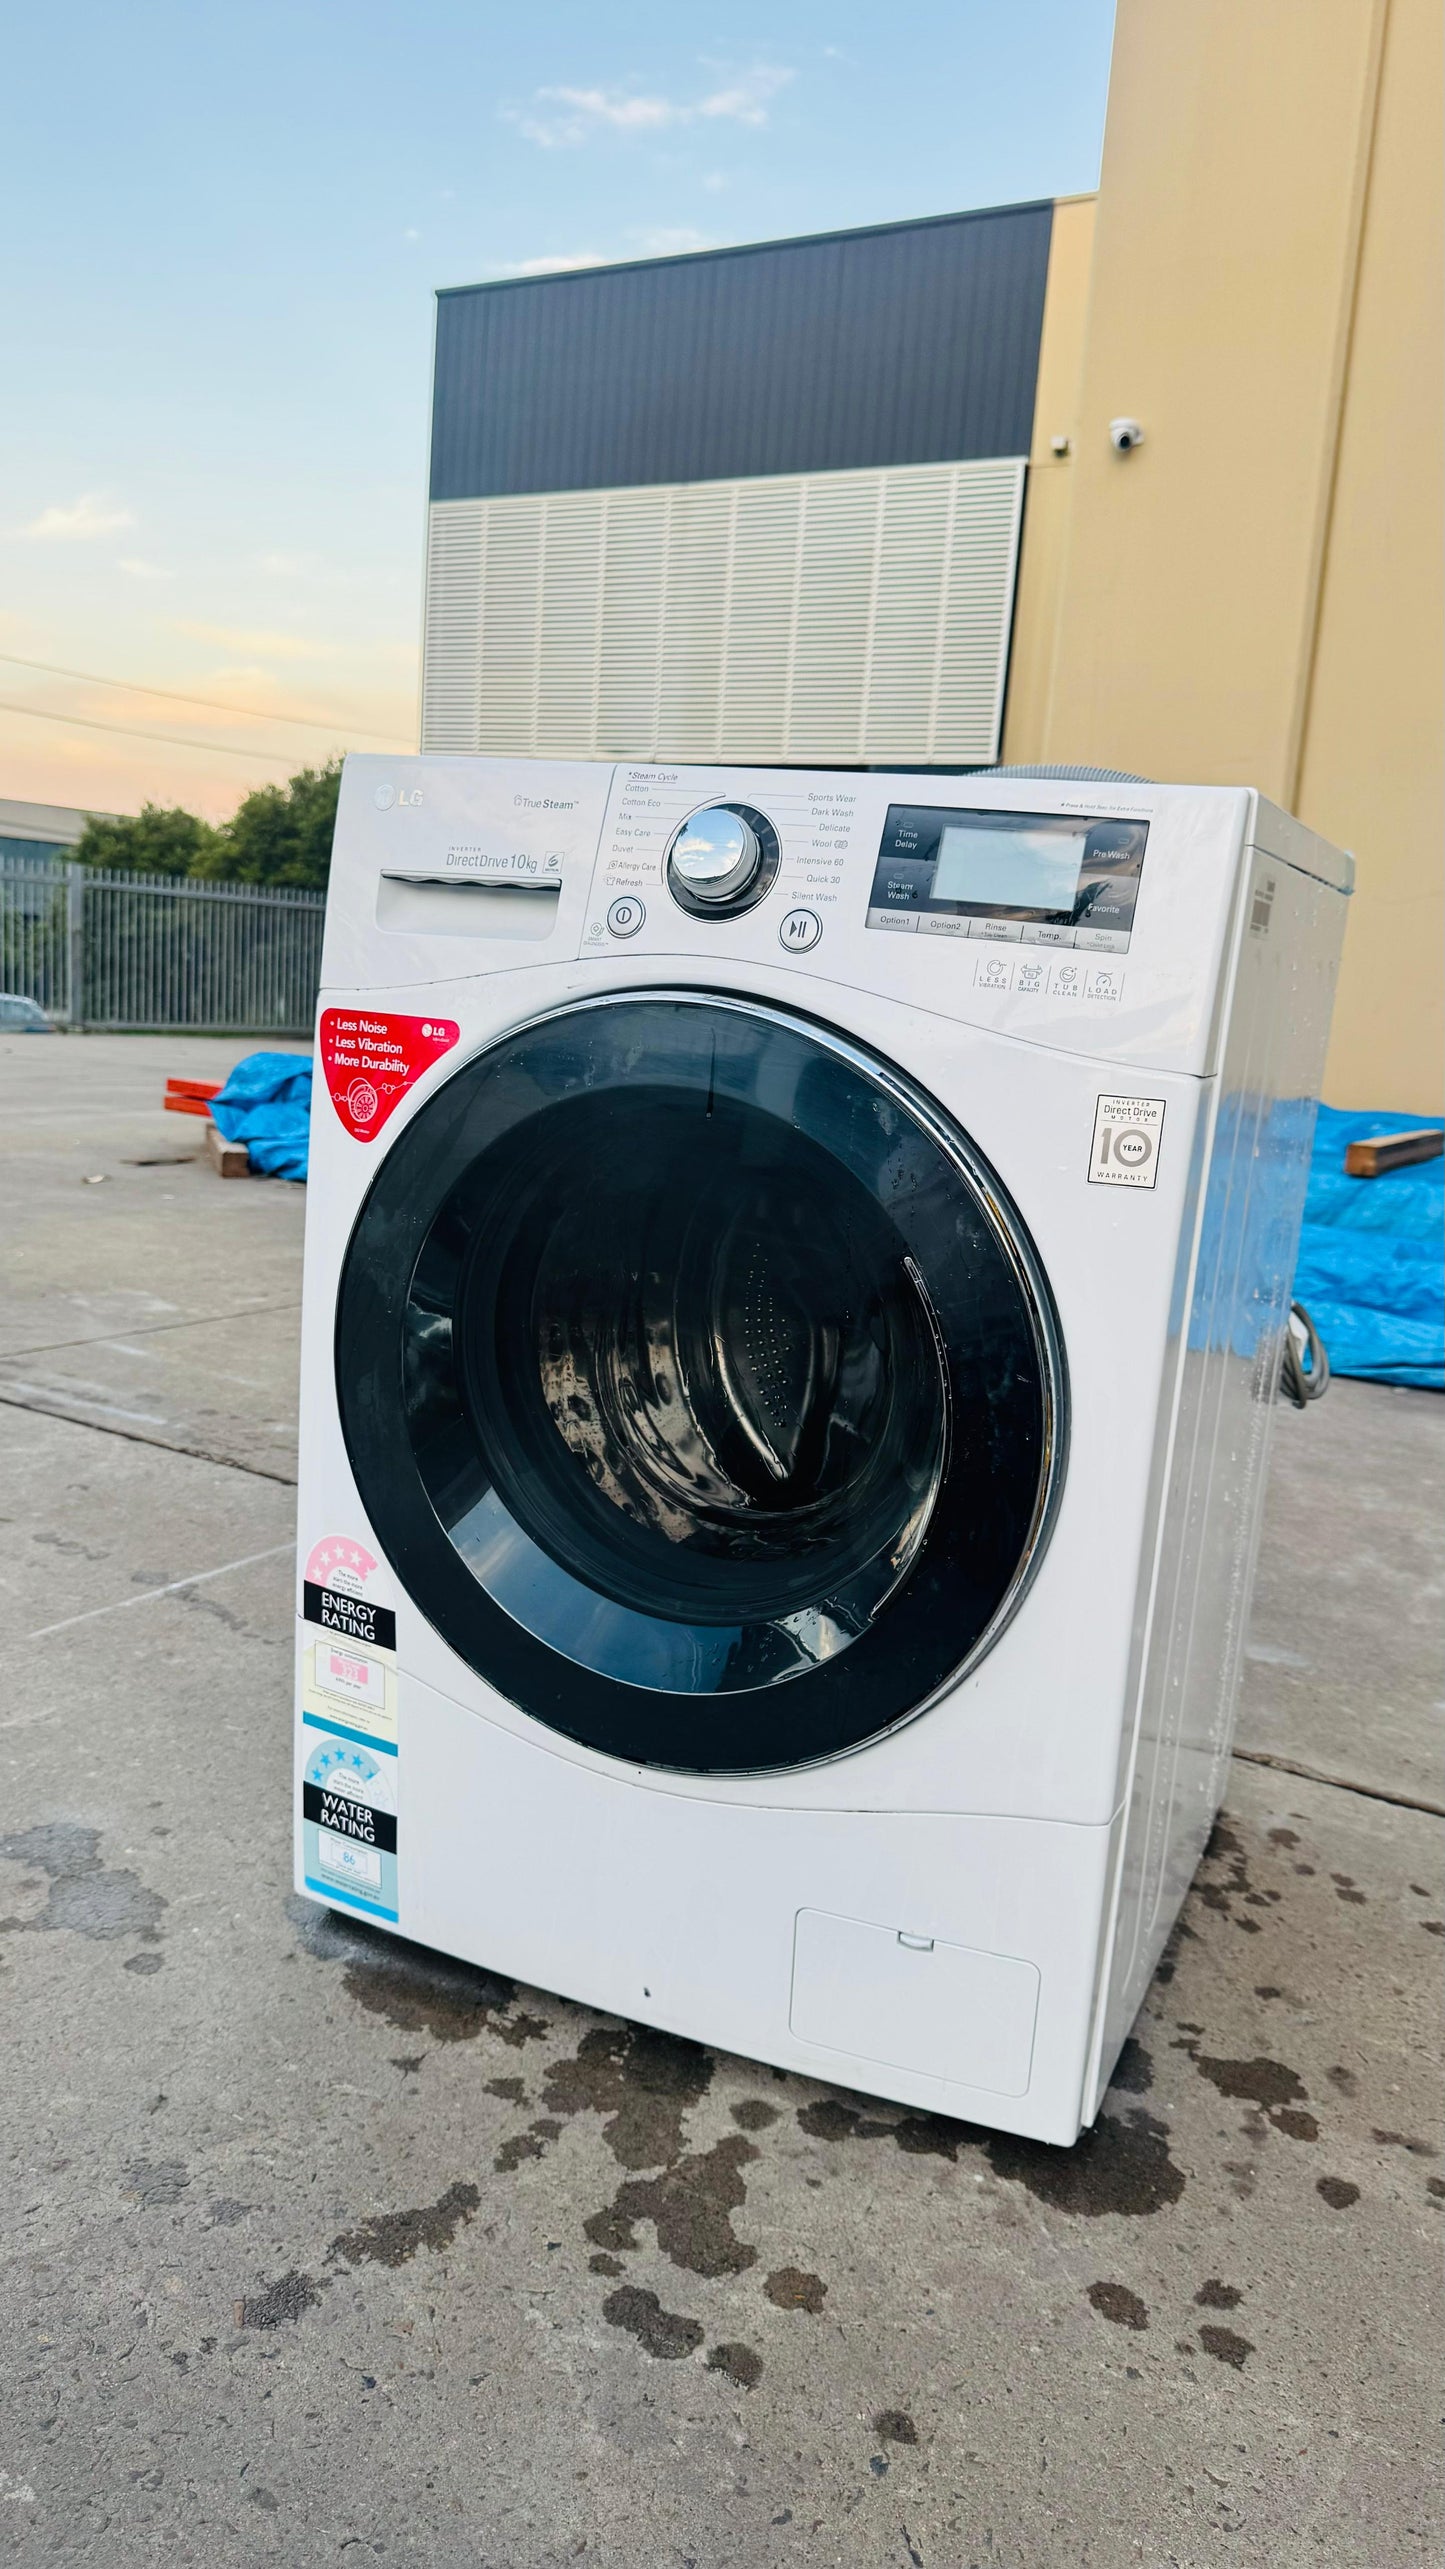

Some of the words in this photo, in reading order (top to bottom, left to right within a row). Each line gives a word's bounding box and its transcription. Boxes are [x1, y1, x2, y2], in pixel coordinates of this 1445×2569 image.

[657, 773, 679, 783] Cycle
[625, 784, 649, 792] Cotton
[399, 789, 424, 807] LG
[622, 797, 646, 806] Cotton
[647, 799, 661, 807] Eco
[808, 793, 834, 802] Sports
[836, 795, 857, 803] Wear
[618, 812, 632, 820] Mix
[811, 808, 830, 816] Dark
[832, 809, 854, 817] Wash
[616, 828, 633, 837] Easy
[634, 829, 651, 837] Care
[819, 823, 851, 832] Delicate
[898, 829, 919, 839] Time
[612, 845, 634, 853] Duvet
[812, 840, 832, 848] Wool
[895, 839, 918, 850] Delay
[618, 861, 641, 871] Allergy
[641, 863, 657, 871] Care
[796, 856, 833, 865] Intensive
[834, 858, 844, 866] 60
[615, 878, 643, 887] Refresh
[806, 874, 829, 883] Quick
[830, 876, 841, 884] 30
[887, 880, 914, 890] Steam
[792, 891, 814, 900] Silent
[816, 893, 838, 902] Wash
[887, 890, 910, 900] Wash
[1087, 903, 1120, 914] Favorite
[880, 915, 910, 925] Option1
[930, 920, 961, 931] Option2
[985, 922, 1007, 932] Rinse
[1038, 930, 1062, 941] Temp.
[1095, 933, 1113, 942] Spin
[979, 975, 1007, 984] LESS
[1018, 979, 1040, 988] BIG
[978, 982, 1006, 990] VIBRATION
[1053, 983, 1078, 992] TUB
[1088, 986, 1118, 996] LOAD
[1052, 990, 1077, 998] CLEAN
[1087, 993, 1117, 1001] DETECTION
[336, 1017, 358, 1031] Less
[359, 1019, 388, 1035] Noise
[433, 1026, 446, 1036] LG
[335, 1035, 356, 1049] Less
[358, 1037, 403, 1054] Vibration
[334, 1053, 359, 1067] More
[361, 1055, 410, 1077] Durability
[1112, 1099, 1151, 1107] INVERTER
[1103, 1104, 1131, 1116] Direct
[1133, 1107, 1157, 1118] Drive
[1100, 1127, 1153, 1167] 10
[1122, 1144, 1143, 1152] YEAR
[1096, 1171, 1148, 1182] WARRANTY
[321, 1591, 377, 1623] ENERGY
[321, 1609, 376, 1641] RATING
[322, 1791, 374, 1826] WATER
[320, 1808, 376, 1843] RATING
[343, 1851, 356, 1866] 86
